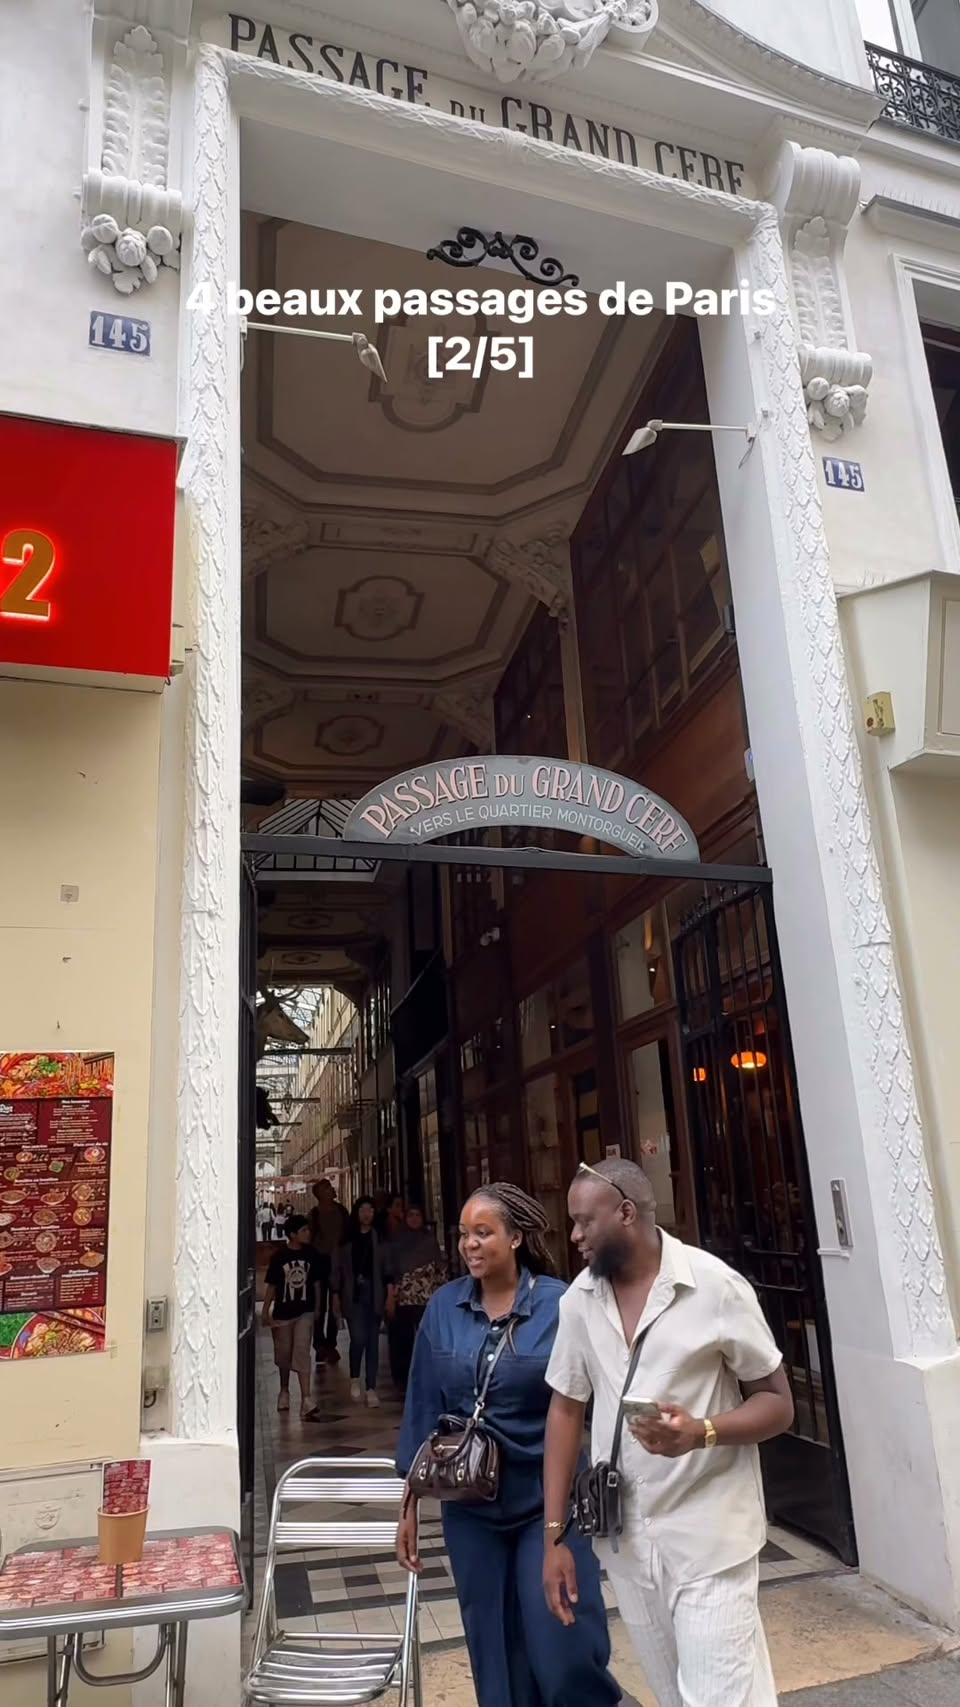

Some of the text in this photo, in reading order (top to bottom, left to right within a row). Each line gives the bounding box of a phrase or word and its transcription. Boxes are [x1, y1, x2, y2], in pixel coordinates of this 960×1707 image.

[228, 13, 428, 108] PASSAGE
[500, 96, 638, 167] GRAND
[91, 314, 150, 352] 145
[825, 460, 862, 489] 145
[0, 528, 55, 621] 2
[359, 763, 689, 853] PASSAGE DU GRAND CERF
[409, 803, 647, 854] VERS LE QUARTIER MONTORGUEIL
